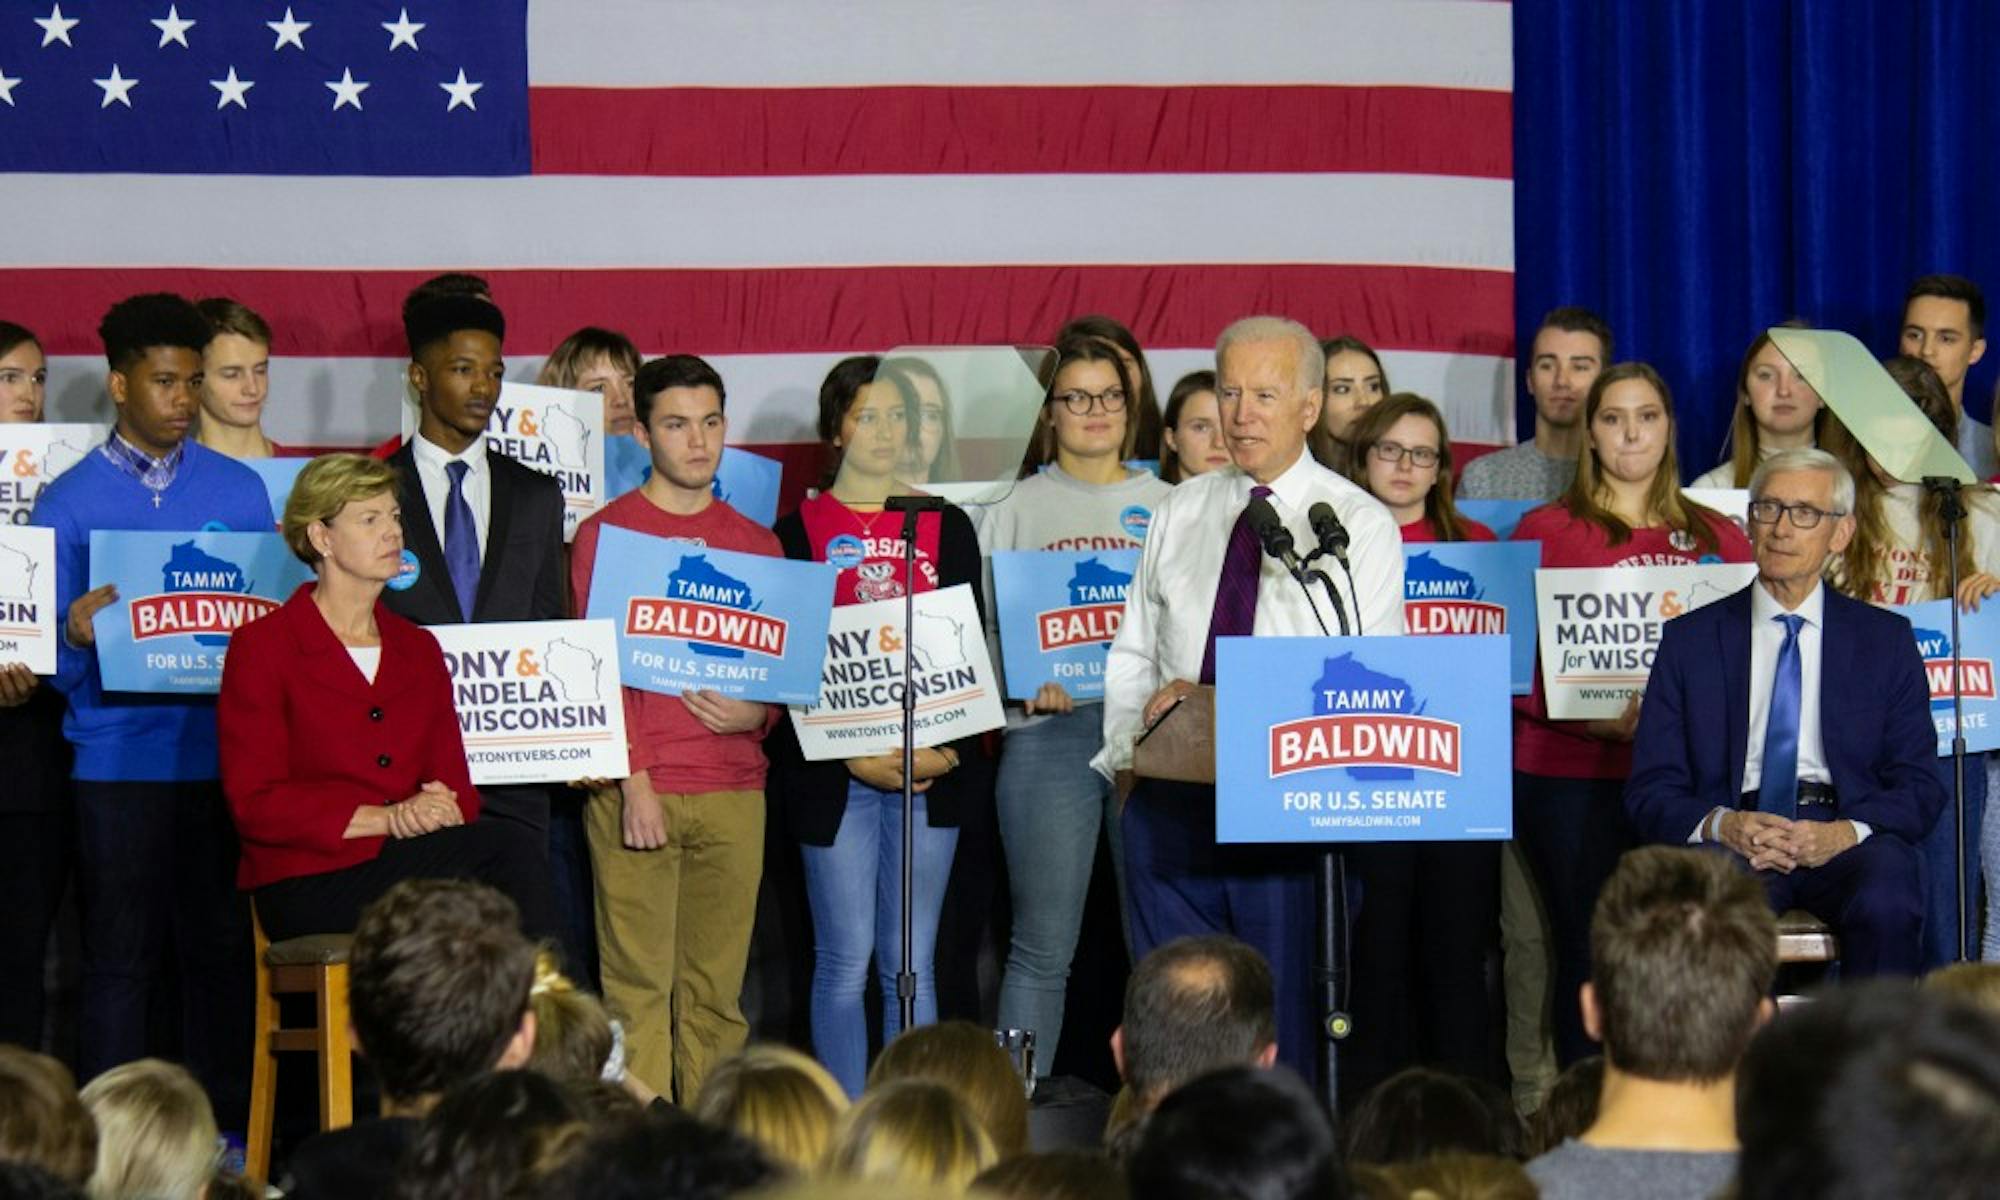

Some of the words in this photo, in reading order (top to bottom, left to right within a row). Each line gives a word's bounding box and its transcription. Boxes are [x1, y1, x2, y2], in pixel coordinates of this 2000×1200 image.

[519, 409, 538, 437] &
[172, 571, 237, 588] TAMMY
[1407, 581, 1470, 596] TAMMY
[678, 580, 745, 605] TAMMY
[1553, 592, 1654, 620] TONY
[1658, 590, 1682, 618] &
[634, 604, 780, 650] BALDWIN
[880, 624, 903, 653] &
[147, 654, 177, 668] FOR
[181, 653, 212, 669] U.S.
[516, 648, 541, 677] &
[632, 651, 664, 669] FOR
[669, 657, 701, 677] U.S.
[703, 663, 769, 681] SENATE
[1053, 663, 1085, 677] FOR
[1560, 649, 1587, 673] for
[453, 680, 558, 706] NDELA
[825, 666, 976, 710] WISCONSIN
[1324, 690, 1405, 709] TAMMY
[1280, 723, 1453, 766] BALDWIN
[1284, 792, 1321, 811] FOR
[1328, 791, 1366, 810] U.S.
[1372, 790, 1447, 809] SENATE
[1310, 815, 1421, 828] TAMMYBALDWIN.COM
